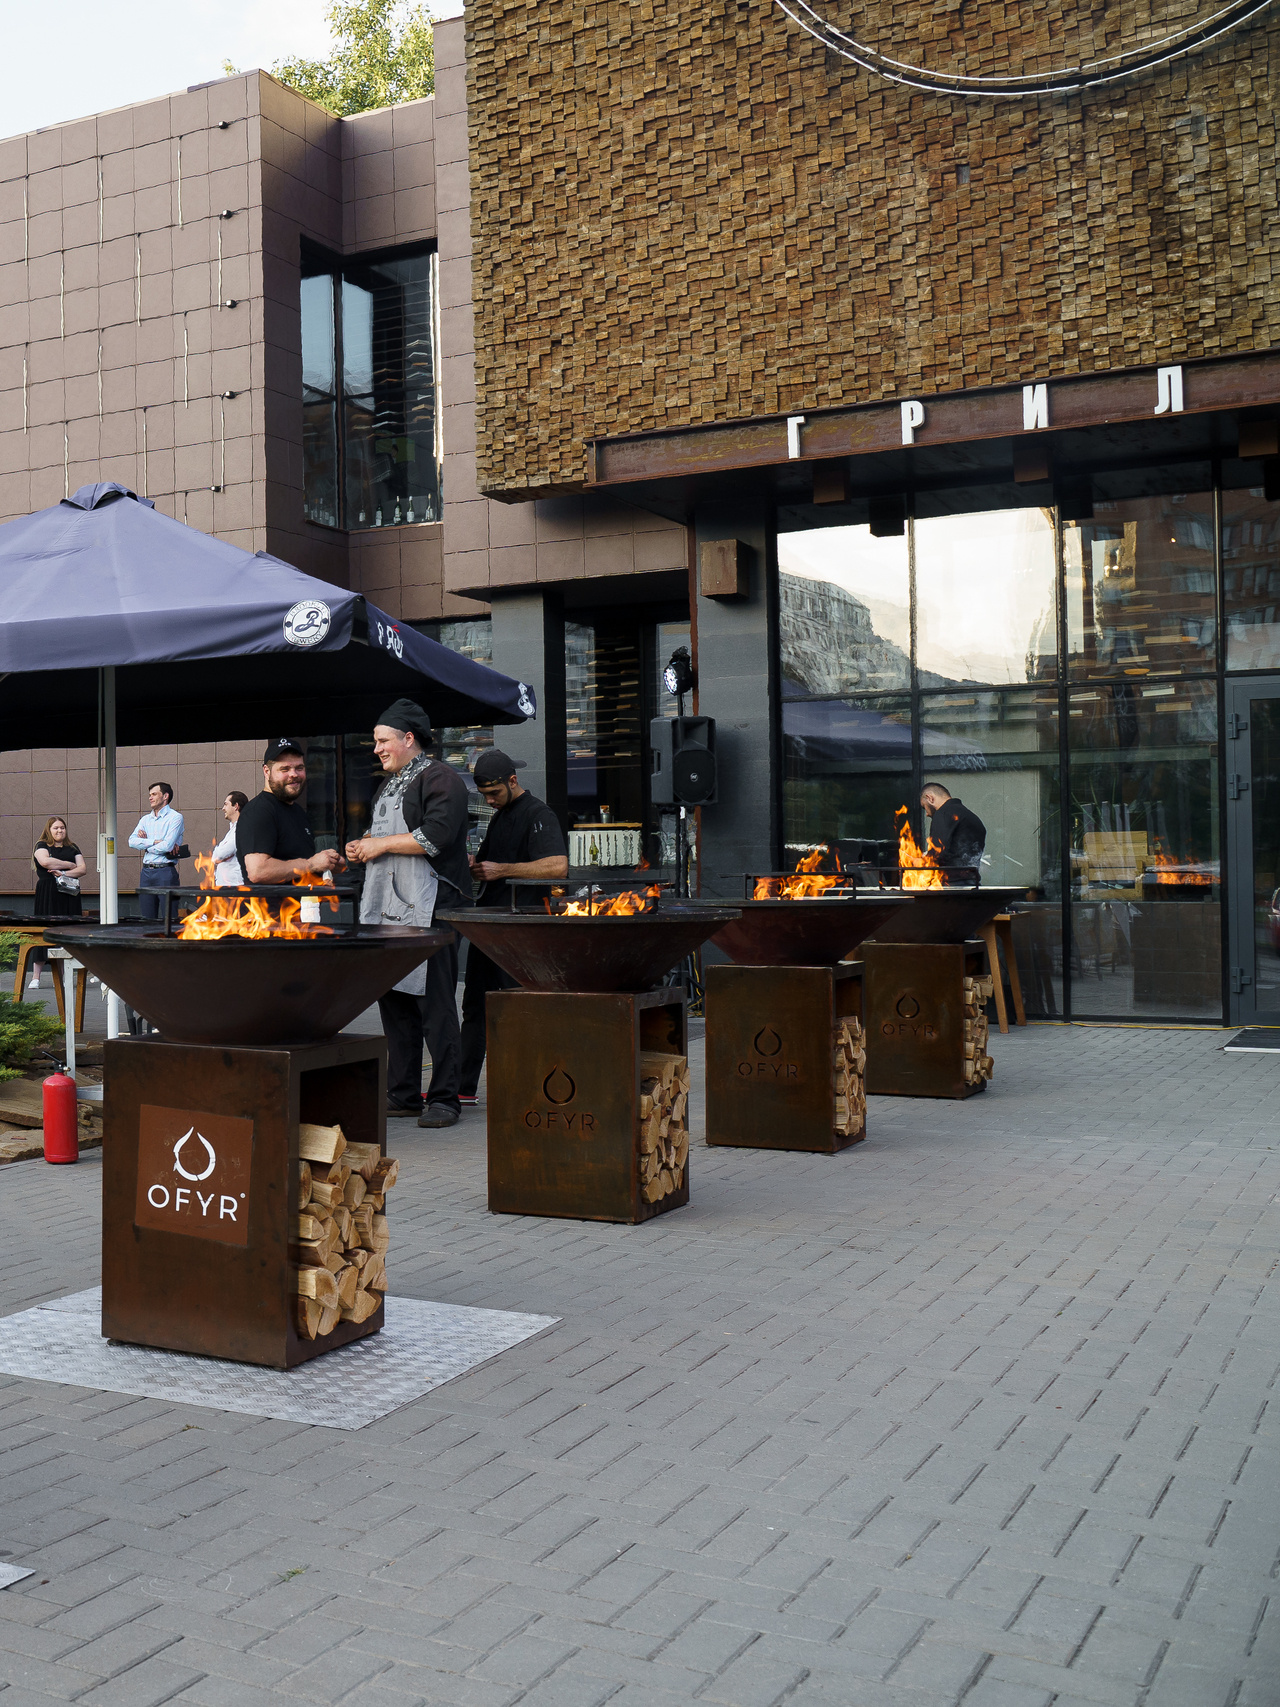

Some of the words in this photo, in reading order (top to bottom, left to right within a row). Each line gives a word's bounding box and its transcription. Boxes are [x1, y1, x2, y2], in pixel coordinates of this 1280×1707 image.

[883, 1023, 934, 1037] OFYR
[738, 1062, 798, 1078] OFYR
[525, 1111, 595, 1131] OFYR
[147, 1184, 238, 1222] OFYR
